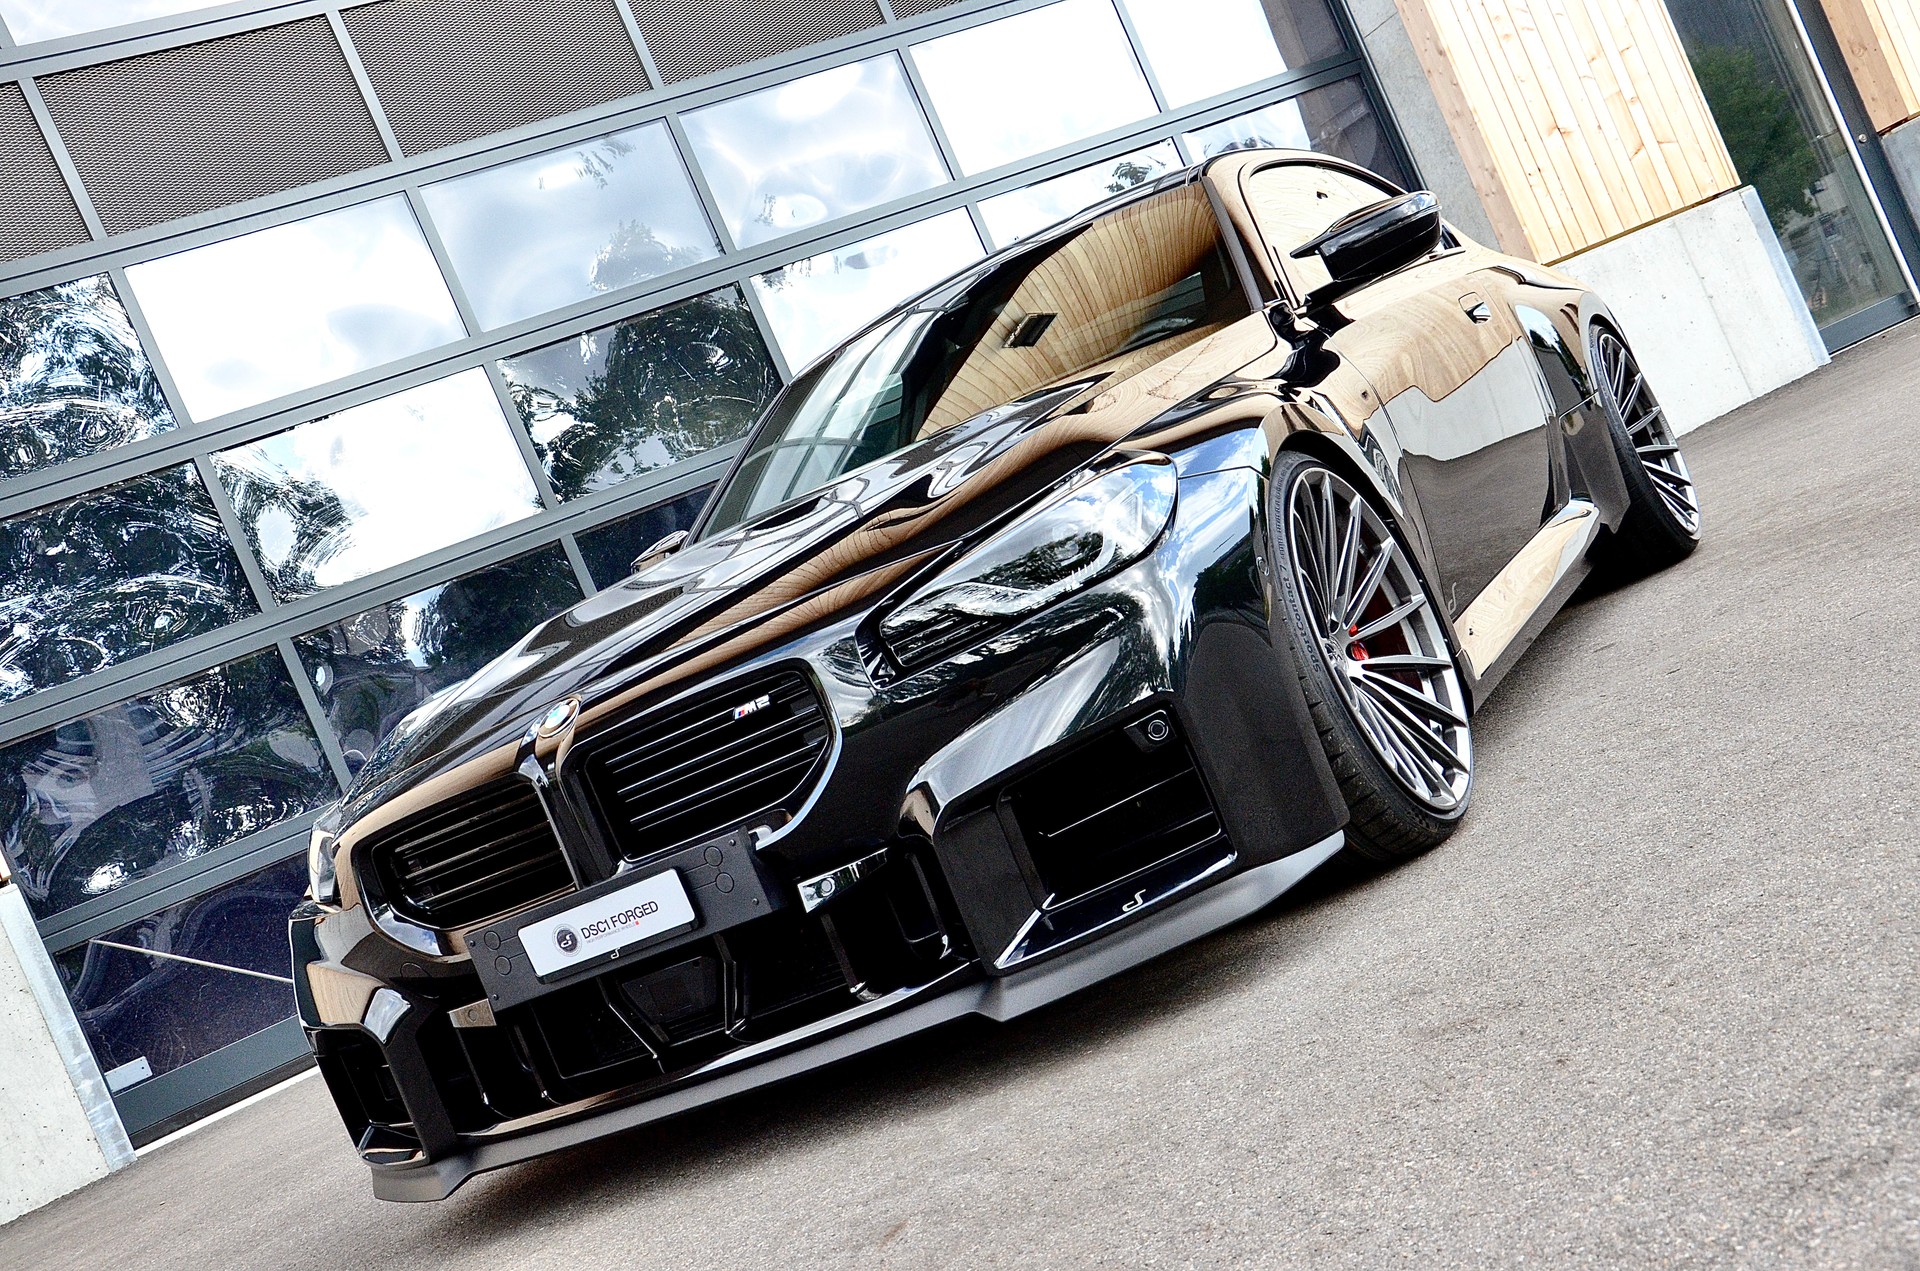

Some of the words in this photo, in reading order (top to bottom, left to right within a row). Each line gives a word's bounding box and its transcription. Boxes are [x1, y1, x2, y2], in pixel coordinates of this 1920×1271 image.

[1283, 577, 1321, 673] SportContact
[735, 695, 770, 720] M2
[580, 919, 611, 939] DSC1
[610, 901, 659, 928] FORGED
